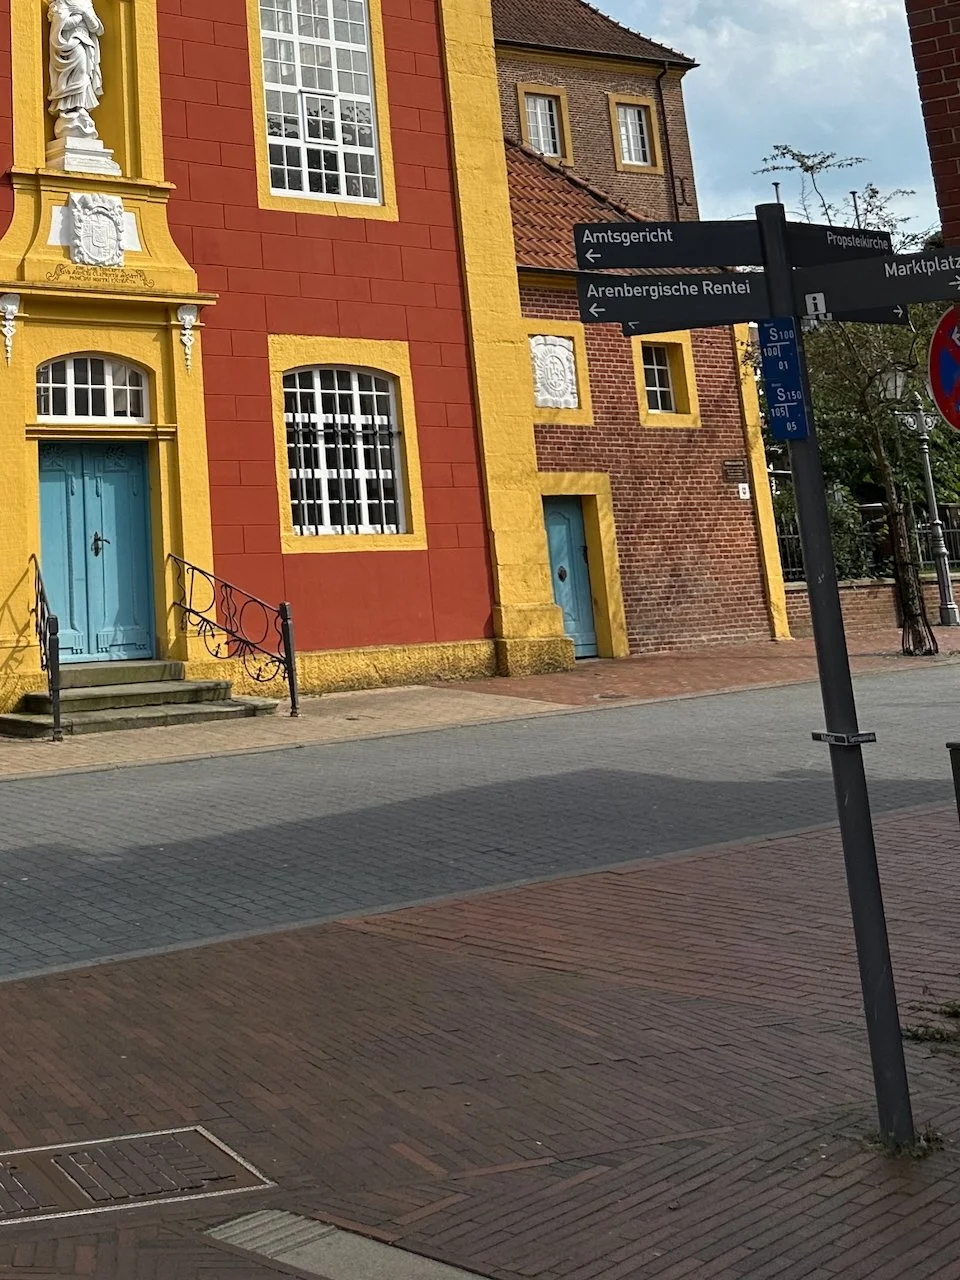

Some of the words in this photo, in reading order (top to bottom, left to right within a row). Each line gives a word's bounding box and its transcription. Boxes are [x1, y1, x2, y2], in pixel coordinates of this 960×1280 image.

[582, 228, 674, 246] Amtsgericht
[827, 230, 888, 250] Propsteikirche
[884, 255, 960, 278] Marktplatz
[587, 281, 698, 300] Arenbergische
[702, 279, 751, 296] Rentei
